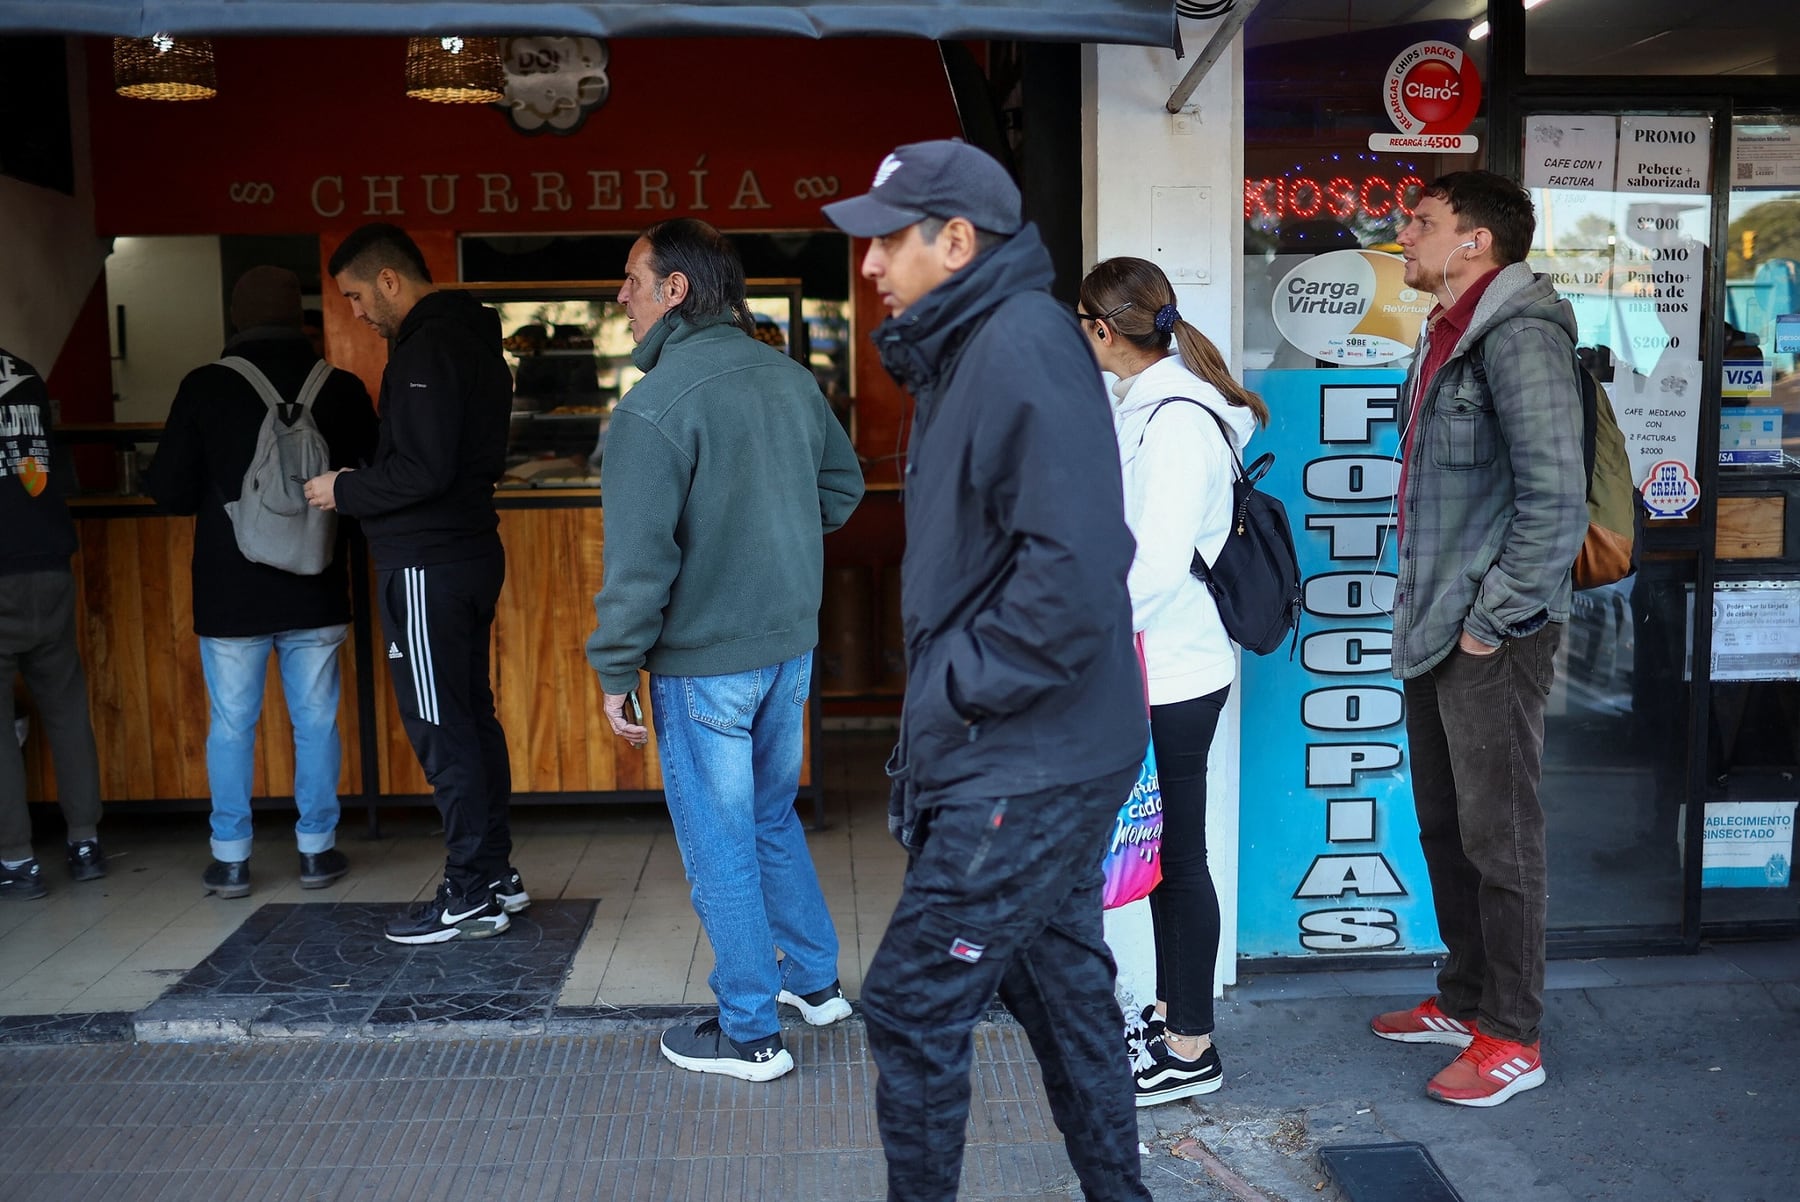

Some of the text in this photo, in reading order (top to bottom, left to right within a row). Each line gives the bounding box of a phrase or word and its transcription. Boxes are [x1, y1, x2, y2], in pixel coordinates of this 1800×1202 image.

[1424, 46, 1456, 60] PACKS
[1396, 50, 1420, 75] CHIPS
[1406, 81, 1456, 100] Claro
[1390, 79, 1412, 130] RECARGAS
[1635, 129, 1696, 144] PROMO
[1544, 158, 1571, 168] CAFE
[1573, 159, 1595, 169] CON
[1638, 163, 1682, 175] Pebete
[311, 155, 771, 216] CHURRERÍA
[1548, 175, 1594, 187] FACTURA
[1627, 176, 1700, 189] saborizada
[1629, 248, 1688, 261] PROMO
[1552, 272, 1603, 284] RGA DE
[1288, 277, 1359, 299] Carga
[1634, 285, 1684, 298] lata de
[1288, 296, 1365, 315] Virtual
[1629, 301, 1688, 313] manaos
[1633, 336, 1679, 349] $2000
[1725, 370, 1764, 384] VISA
[1625, 408, 1686, 417] CAFE MEDIANO
[1637, 434, 1676, 442] FACTURAS
[1640, 447, 1663, 455] $2000
[1719, 453, 1733, 462] ISA
[1661, 467, 1676, 481] ICE
[1651, 482, 1687, 496] CREAM
[1291, 384, 1408, 950] FOTOCOPIAS
[1704, 815, 1791, 826] ABLECIMIENTO
[1703, 829, 1775, 839] SINSECTADO
